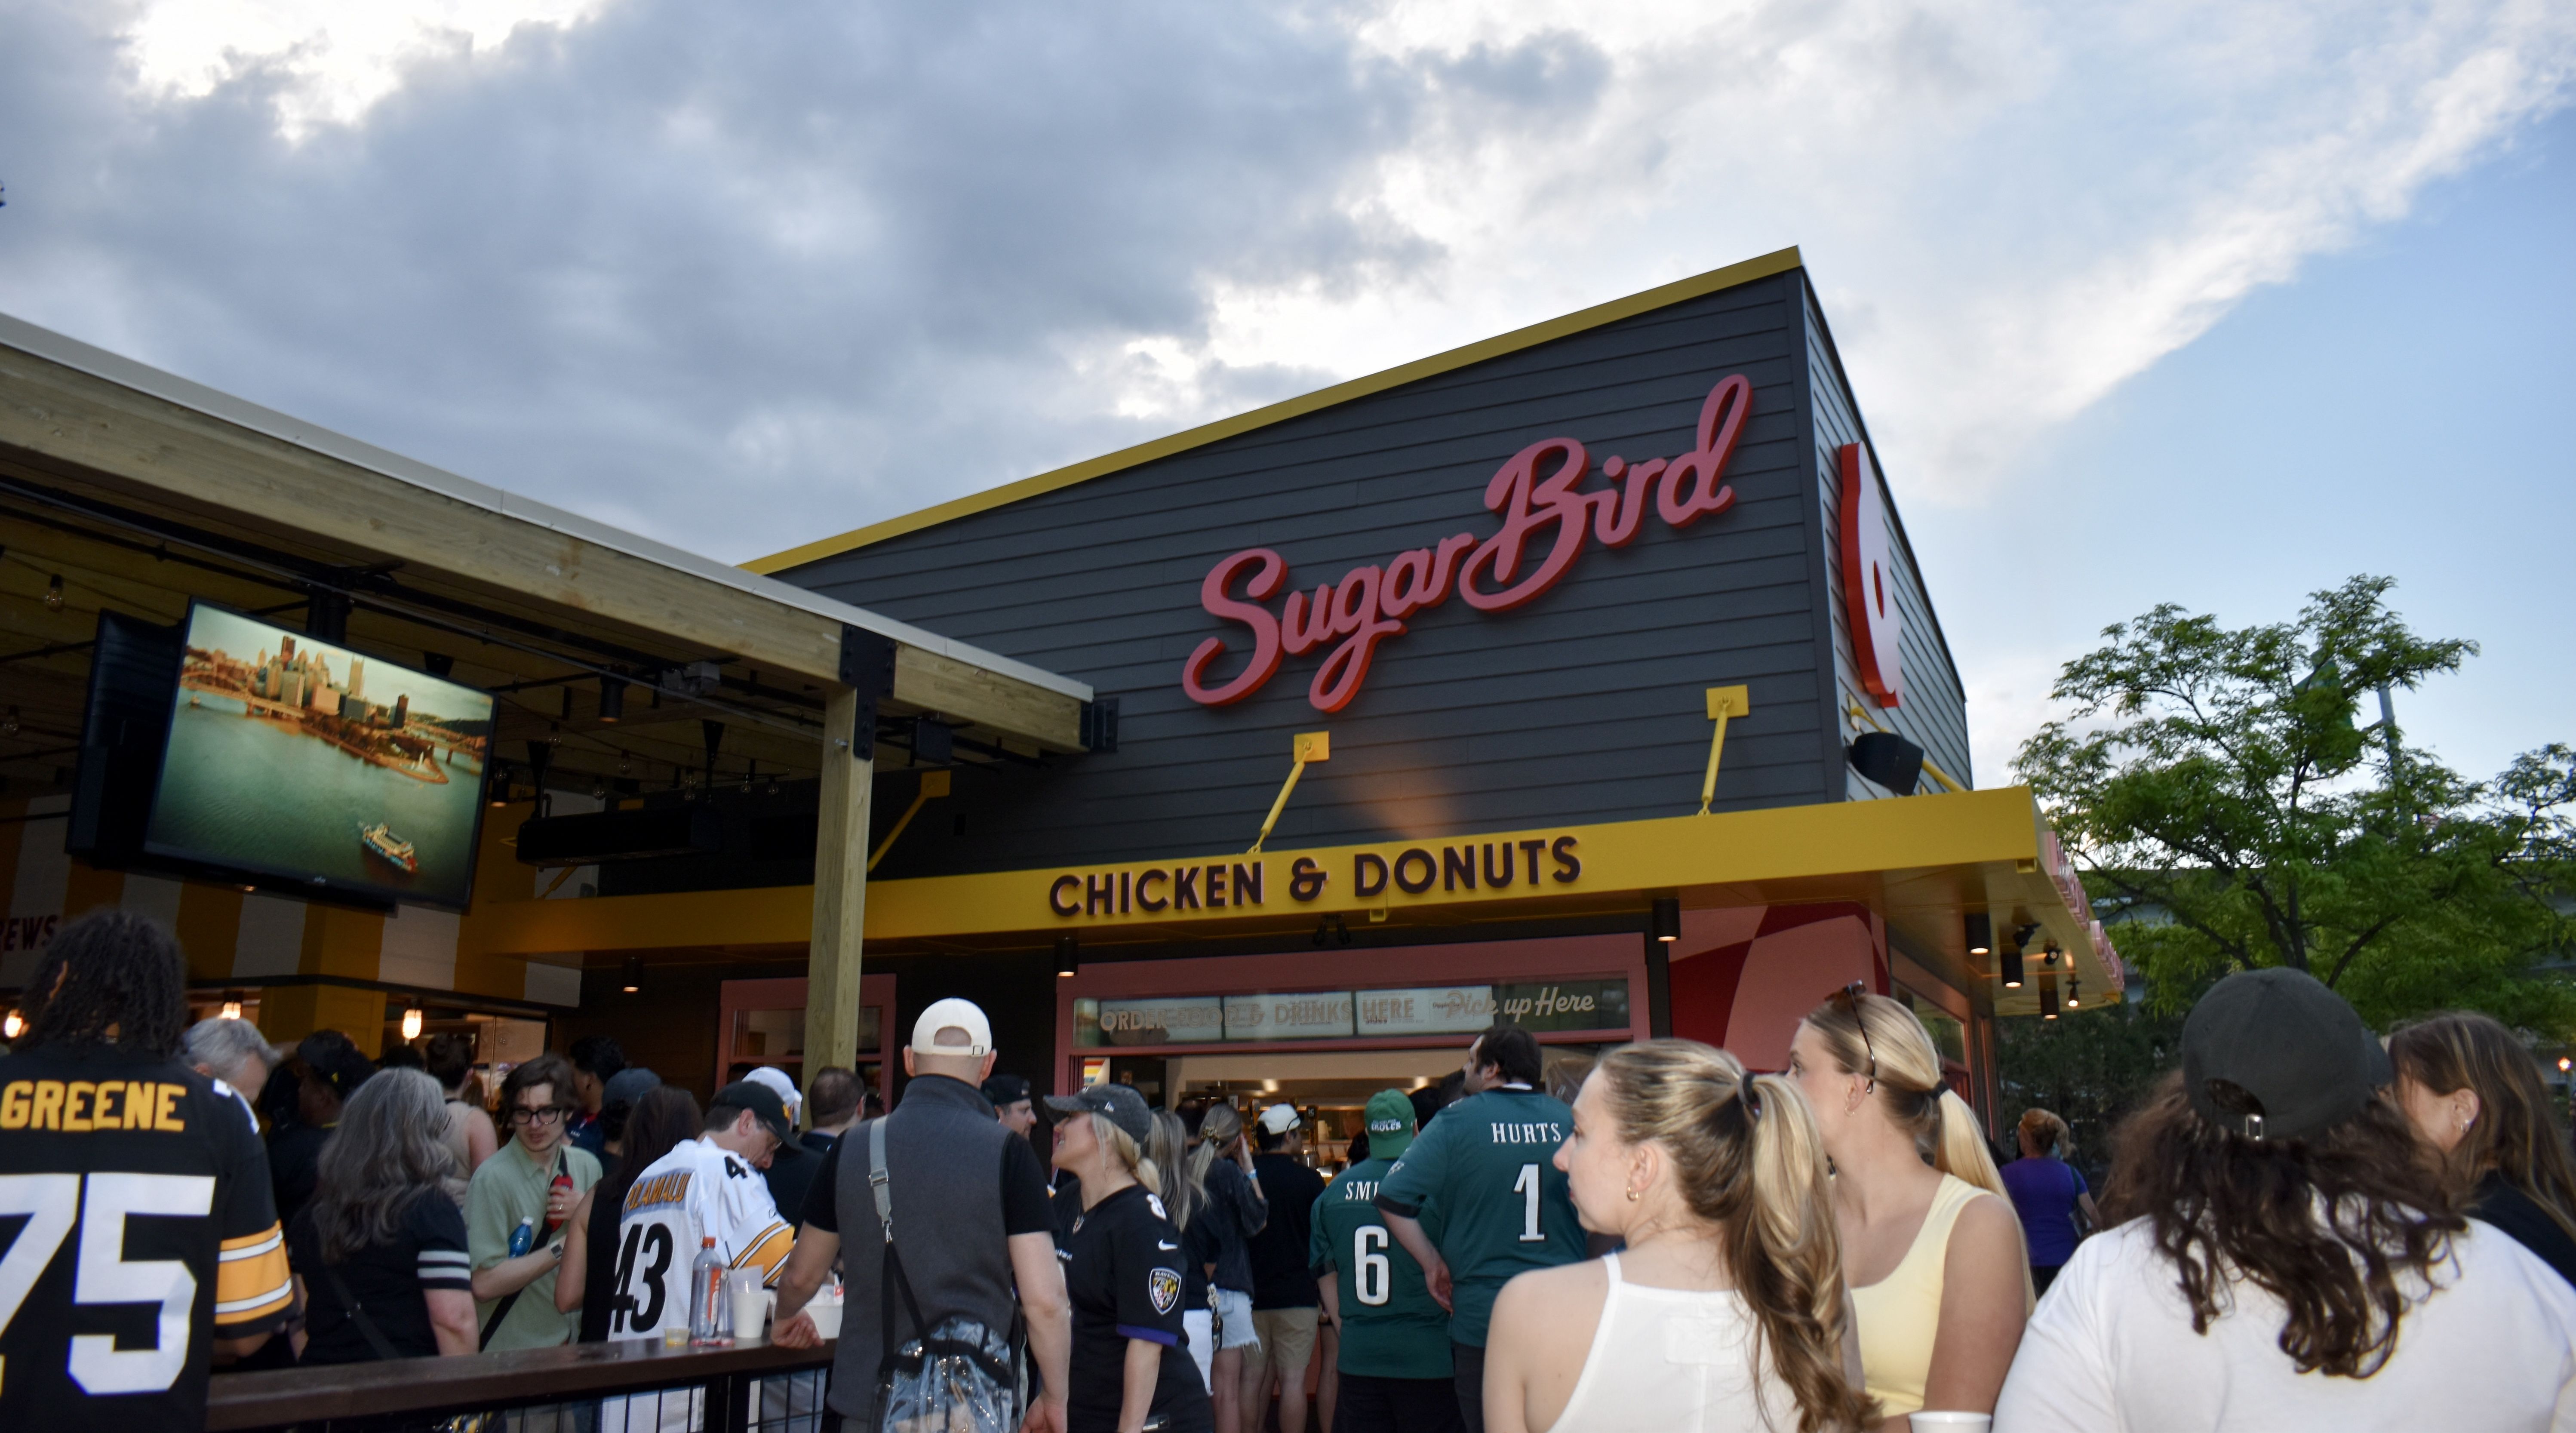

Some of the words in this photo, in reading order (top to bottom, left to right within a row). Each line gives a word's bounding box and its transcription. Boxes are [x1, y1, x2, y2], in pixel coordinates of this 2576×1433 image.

[1049, 861, 1264, 917] CHICKEN
[1289, 857, 1328, 902] &
[1354, 836, 1582, 897] DONUTS
[1100, 1009, 1168, 1031] ORDER
[1177, 1006, 1239, 1027] FOOD
[1275, 1000, 1353, 1025] DRINKS
[1362, 998, 1414, 1020] HERE
[1446, 990, 1499, 1019] Pick
[1504, 997, 1532, 1023] up
[1535, 986, 1595, 1016] Here
[1, 1080, 187, 1132] GREENE
[1491, 1122, 1562, 1143] HURTS
[1513, 1163, 1545, 1242] 1
[0, 1172, 216, 1395] 75
[612, 1222, 673, 1333] 43
[1355, 1225, 1389, 1306] 6
